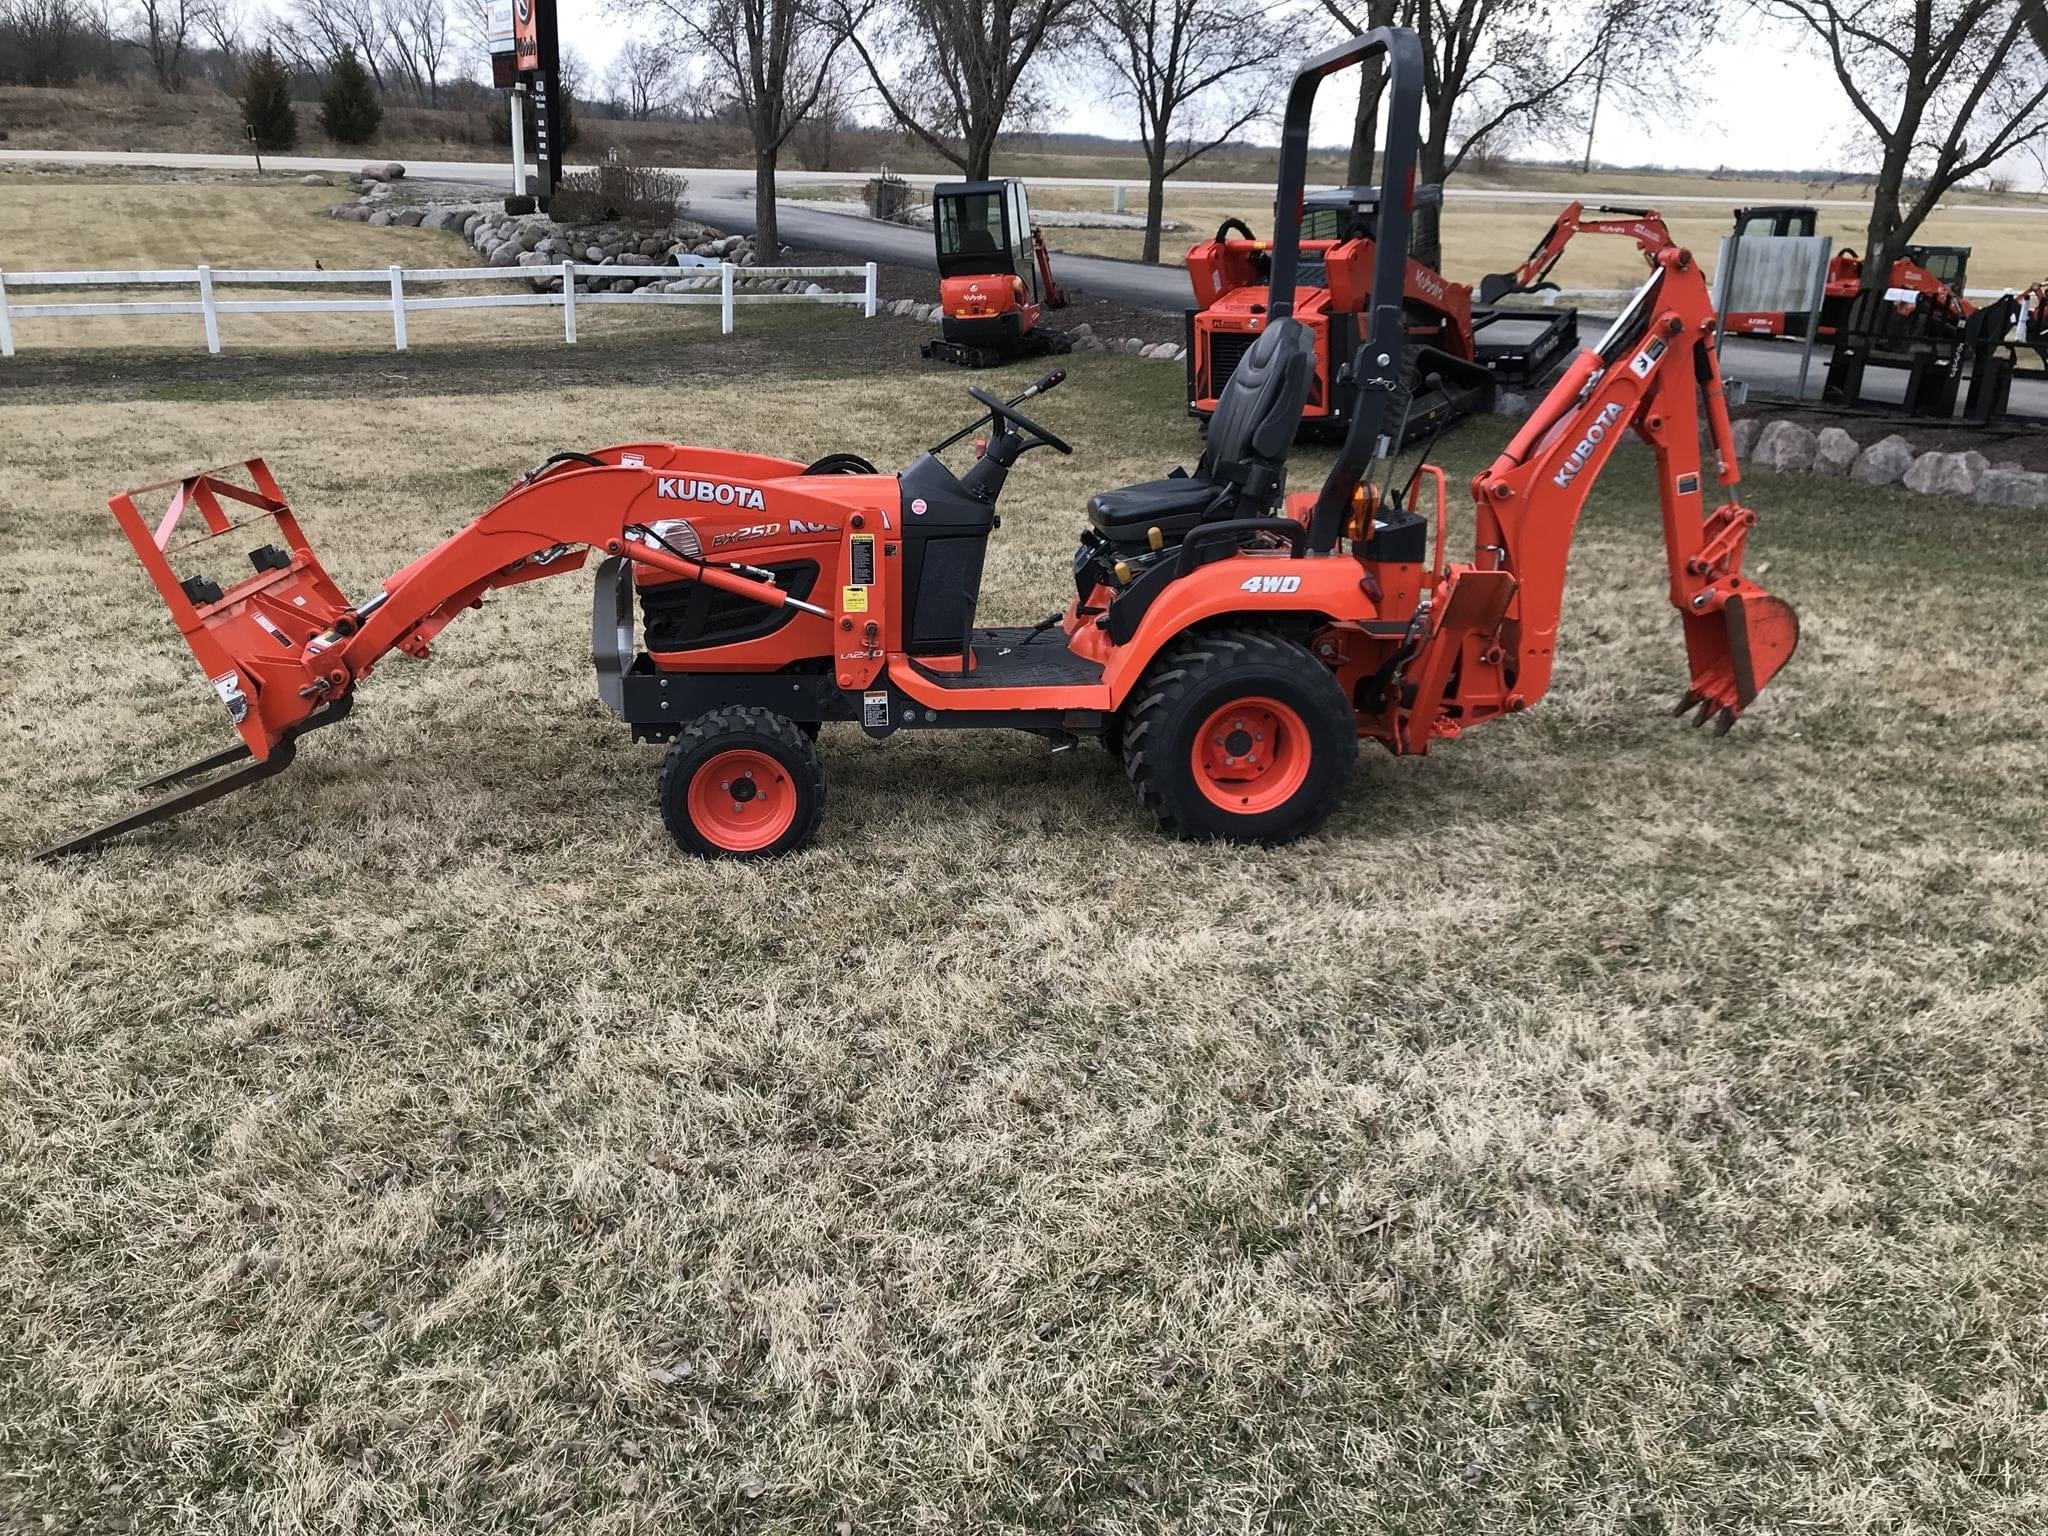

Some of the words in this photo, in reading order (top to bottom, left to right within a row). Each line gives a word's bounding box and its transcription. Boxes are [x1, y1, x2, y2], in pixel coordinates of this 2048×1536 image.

[1553, 401, 1625, 489] KUBOTA
[657, 477, 766, 511] KUBOTA
[1240, 575, 1301, 593] 4WD
